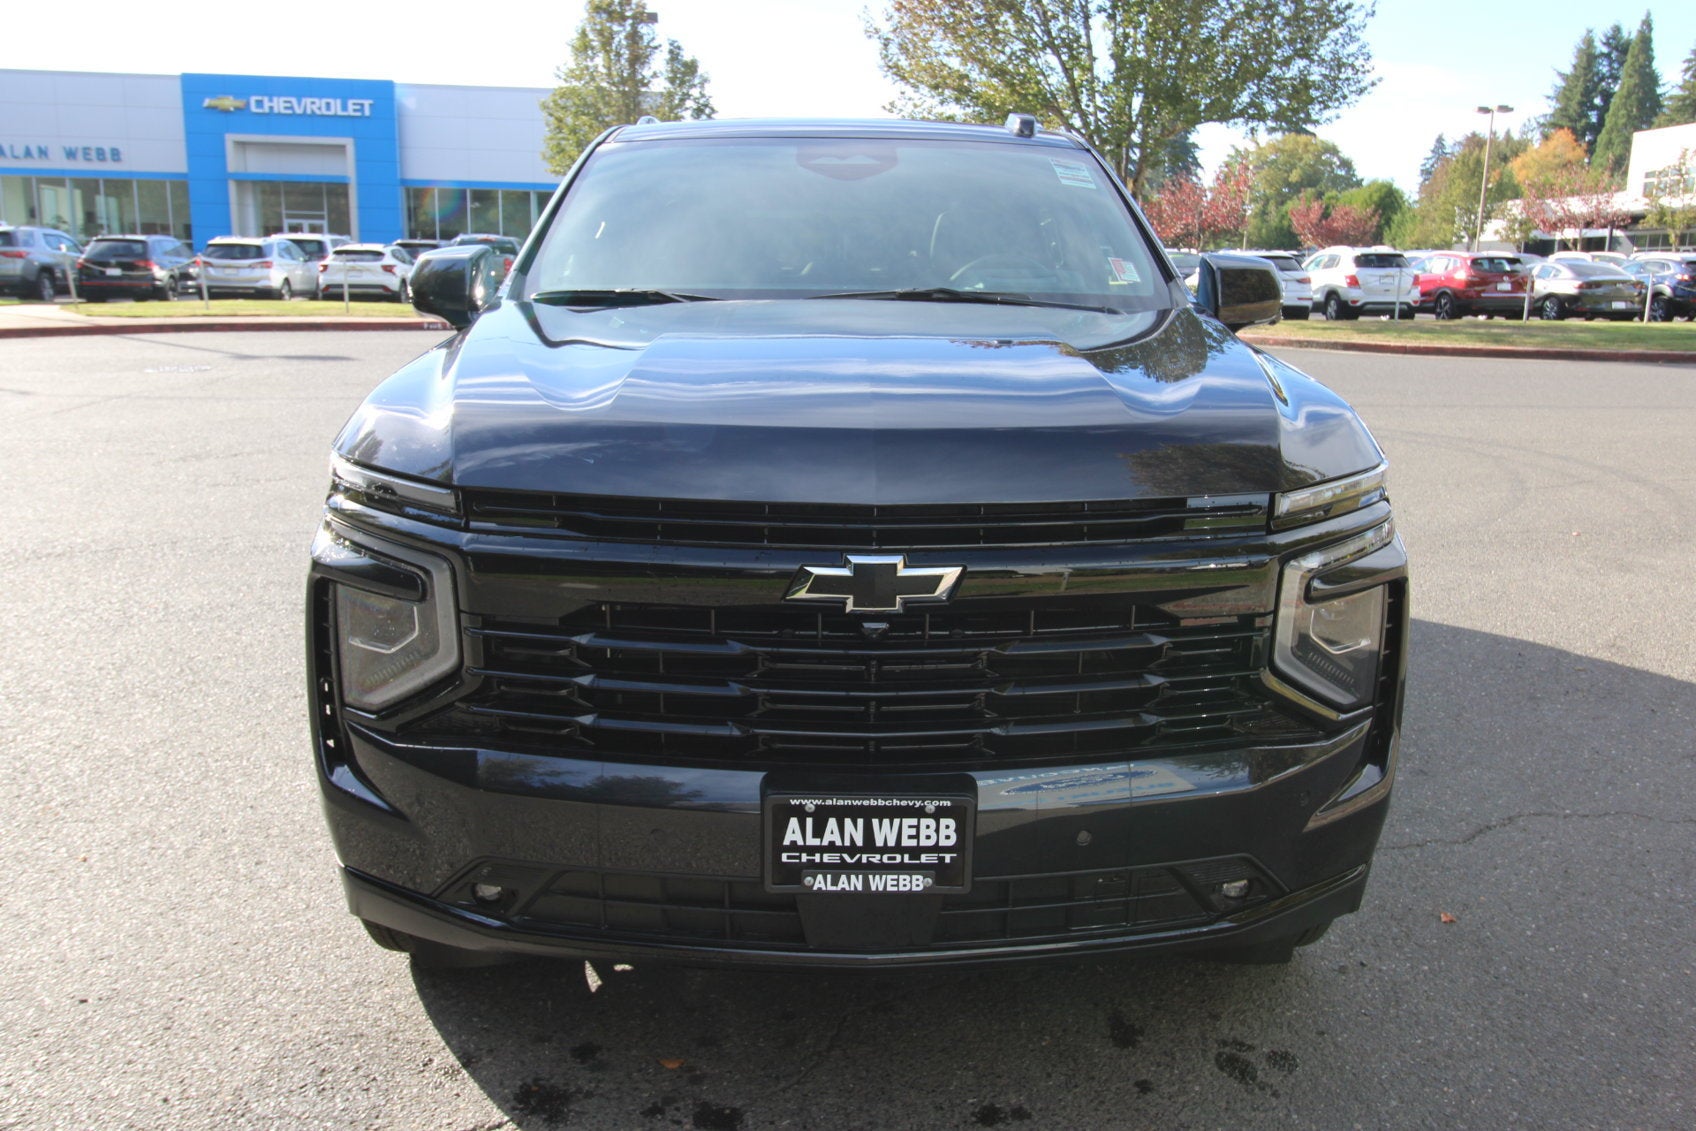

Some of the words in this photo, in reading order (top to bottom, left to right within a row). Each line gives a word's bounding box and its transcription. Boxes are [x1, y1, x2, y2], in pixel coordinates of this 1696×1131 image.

[249, 95, 374, 117] CHEVROLET
[62, 145, 123, 163] WEBB
[789, 797, 952, 808] www.alanwebbchevy.com
[782, 817, 864, 847] ALAN
[871, 817, 957, 847] WEBB
[781, 852, 957, 864] CHEVROLET
[812, 873, 863, 891] ALAN
[868, 874, 924, 892] WEBB
